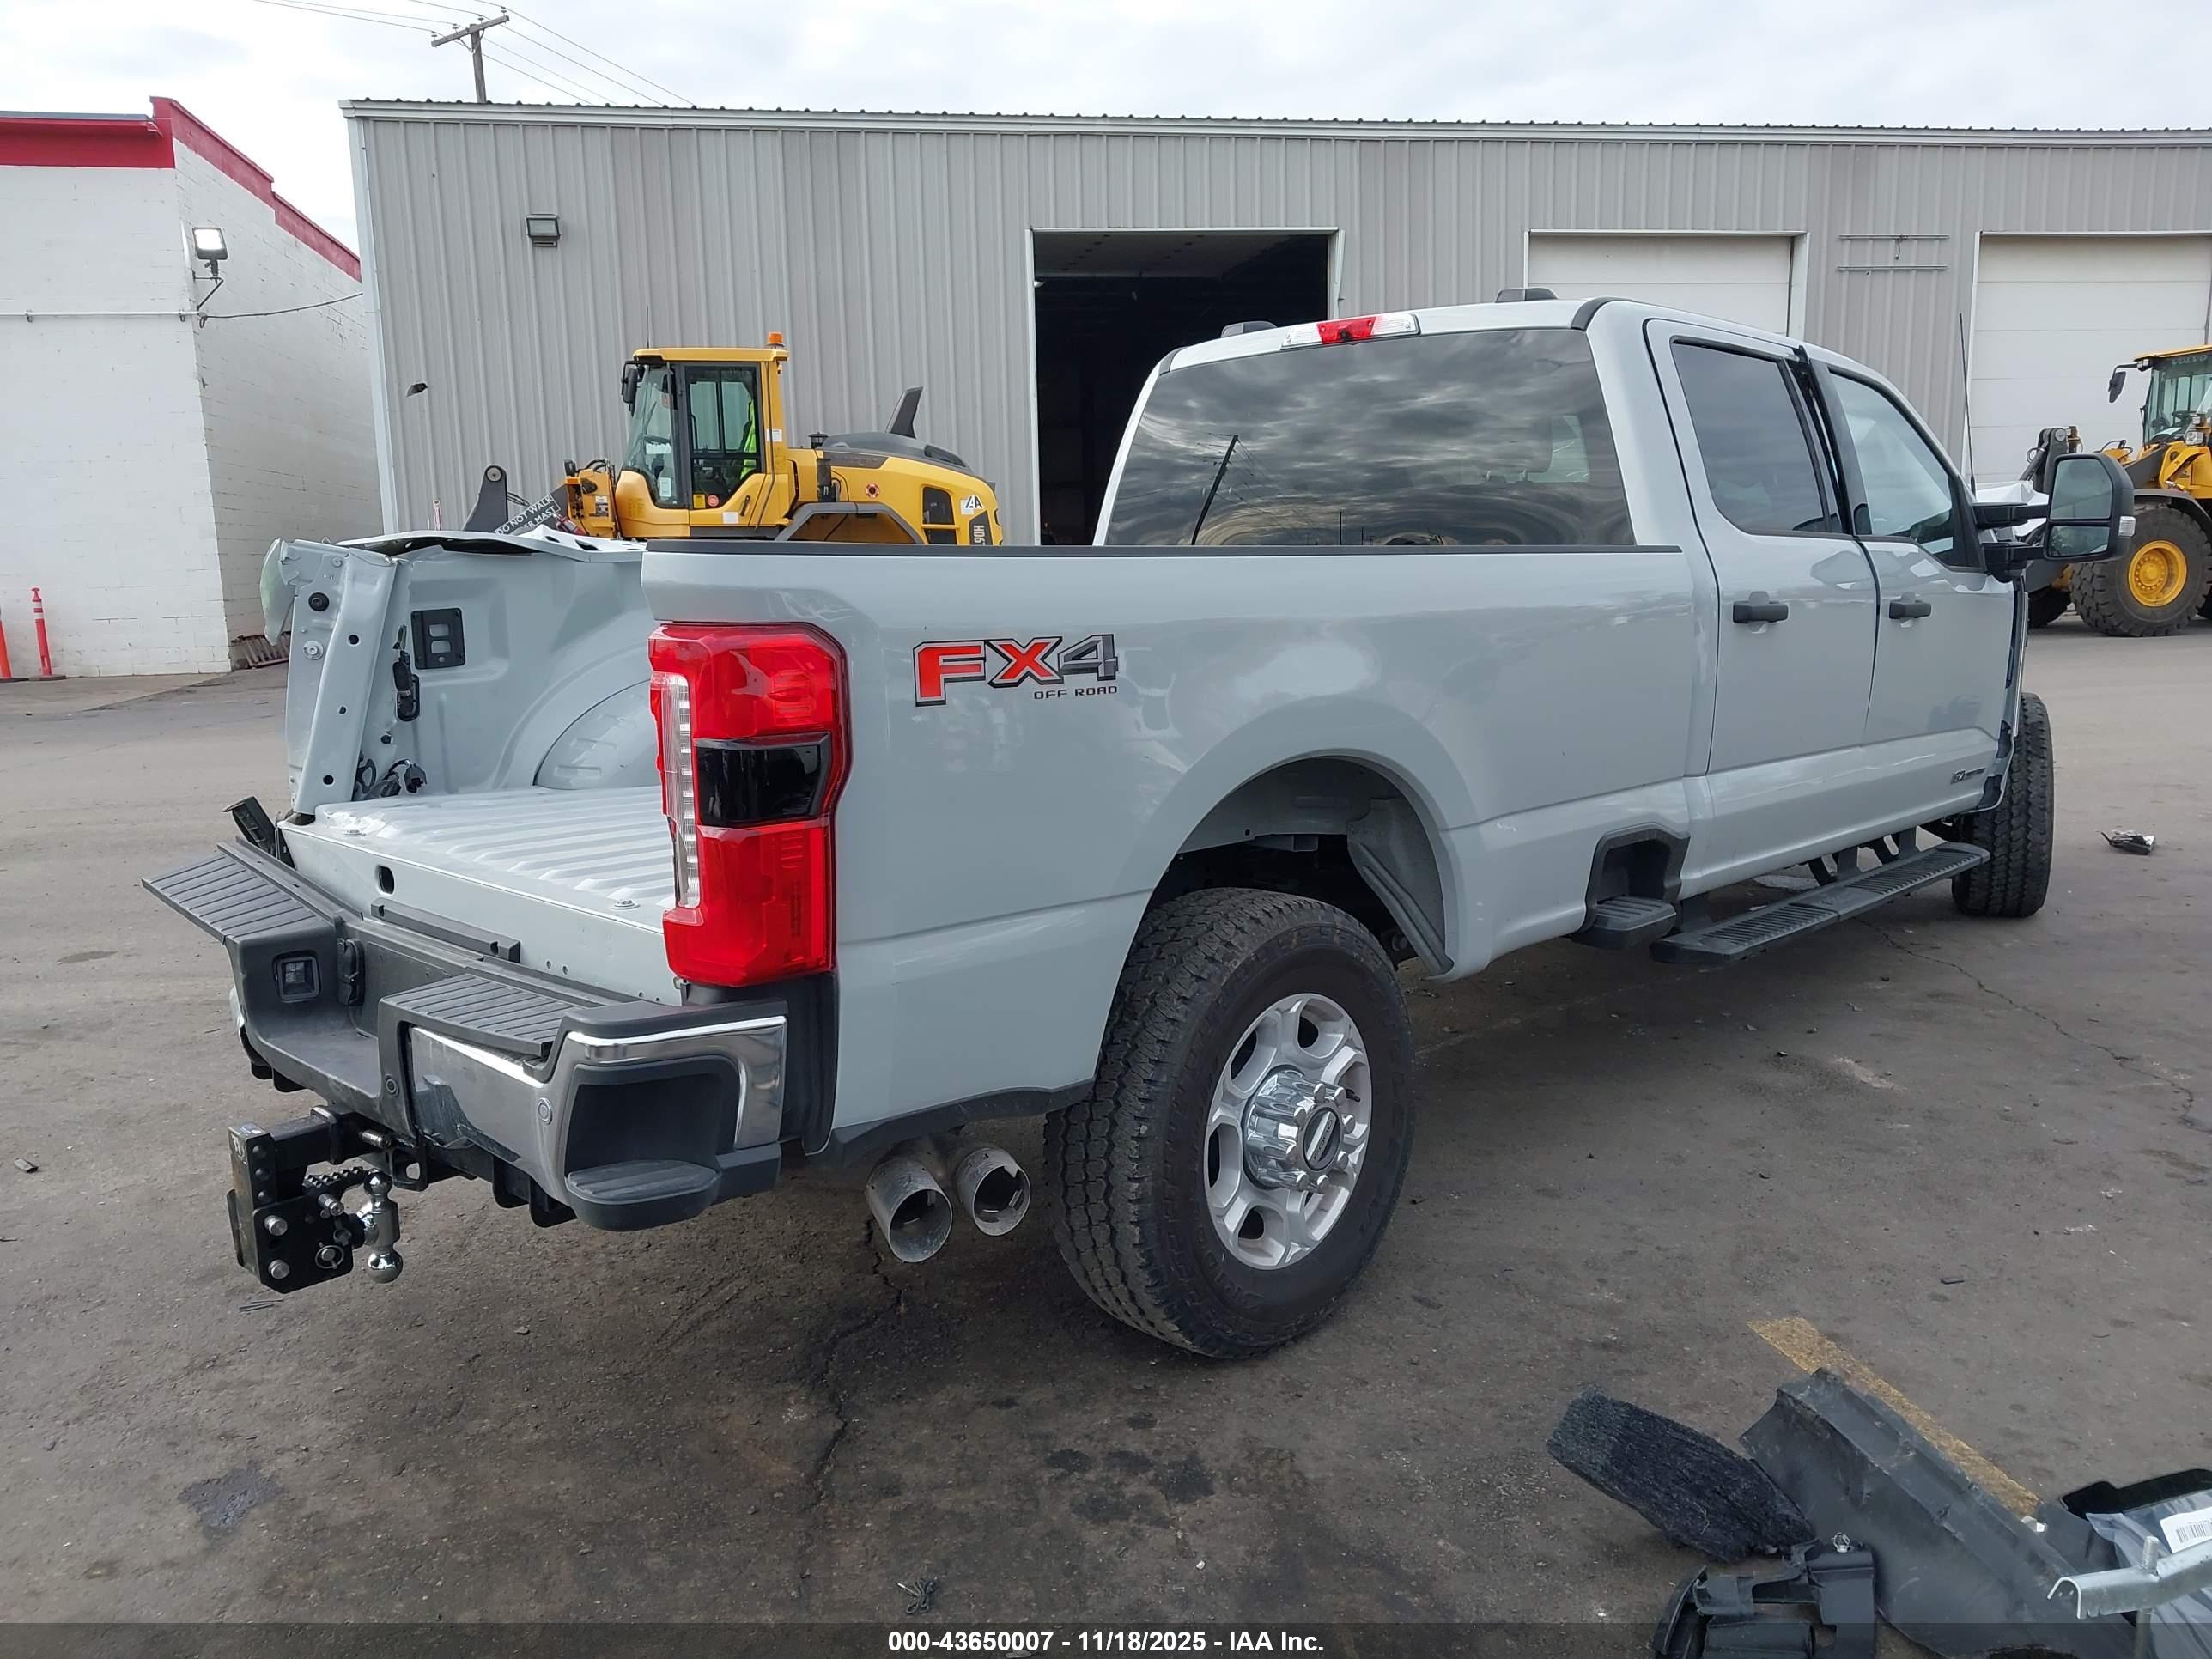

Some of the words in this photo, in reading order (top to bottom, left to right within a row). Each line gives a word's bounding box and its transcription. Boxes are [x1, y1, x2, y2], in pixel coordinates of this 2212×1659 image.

[496, 524, 510, 535] DO
[510, 513, 529, 528] NOT
[529, 496, 554, 514] WALK
[534, 506, 556, 524] MAST
[973, 525, 986, 545] 90H
[912, 633, 1120, 707] FX4
[1034, 690, 1068, 700] OFF
[1074, 685, 1118, 697] ROAD
